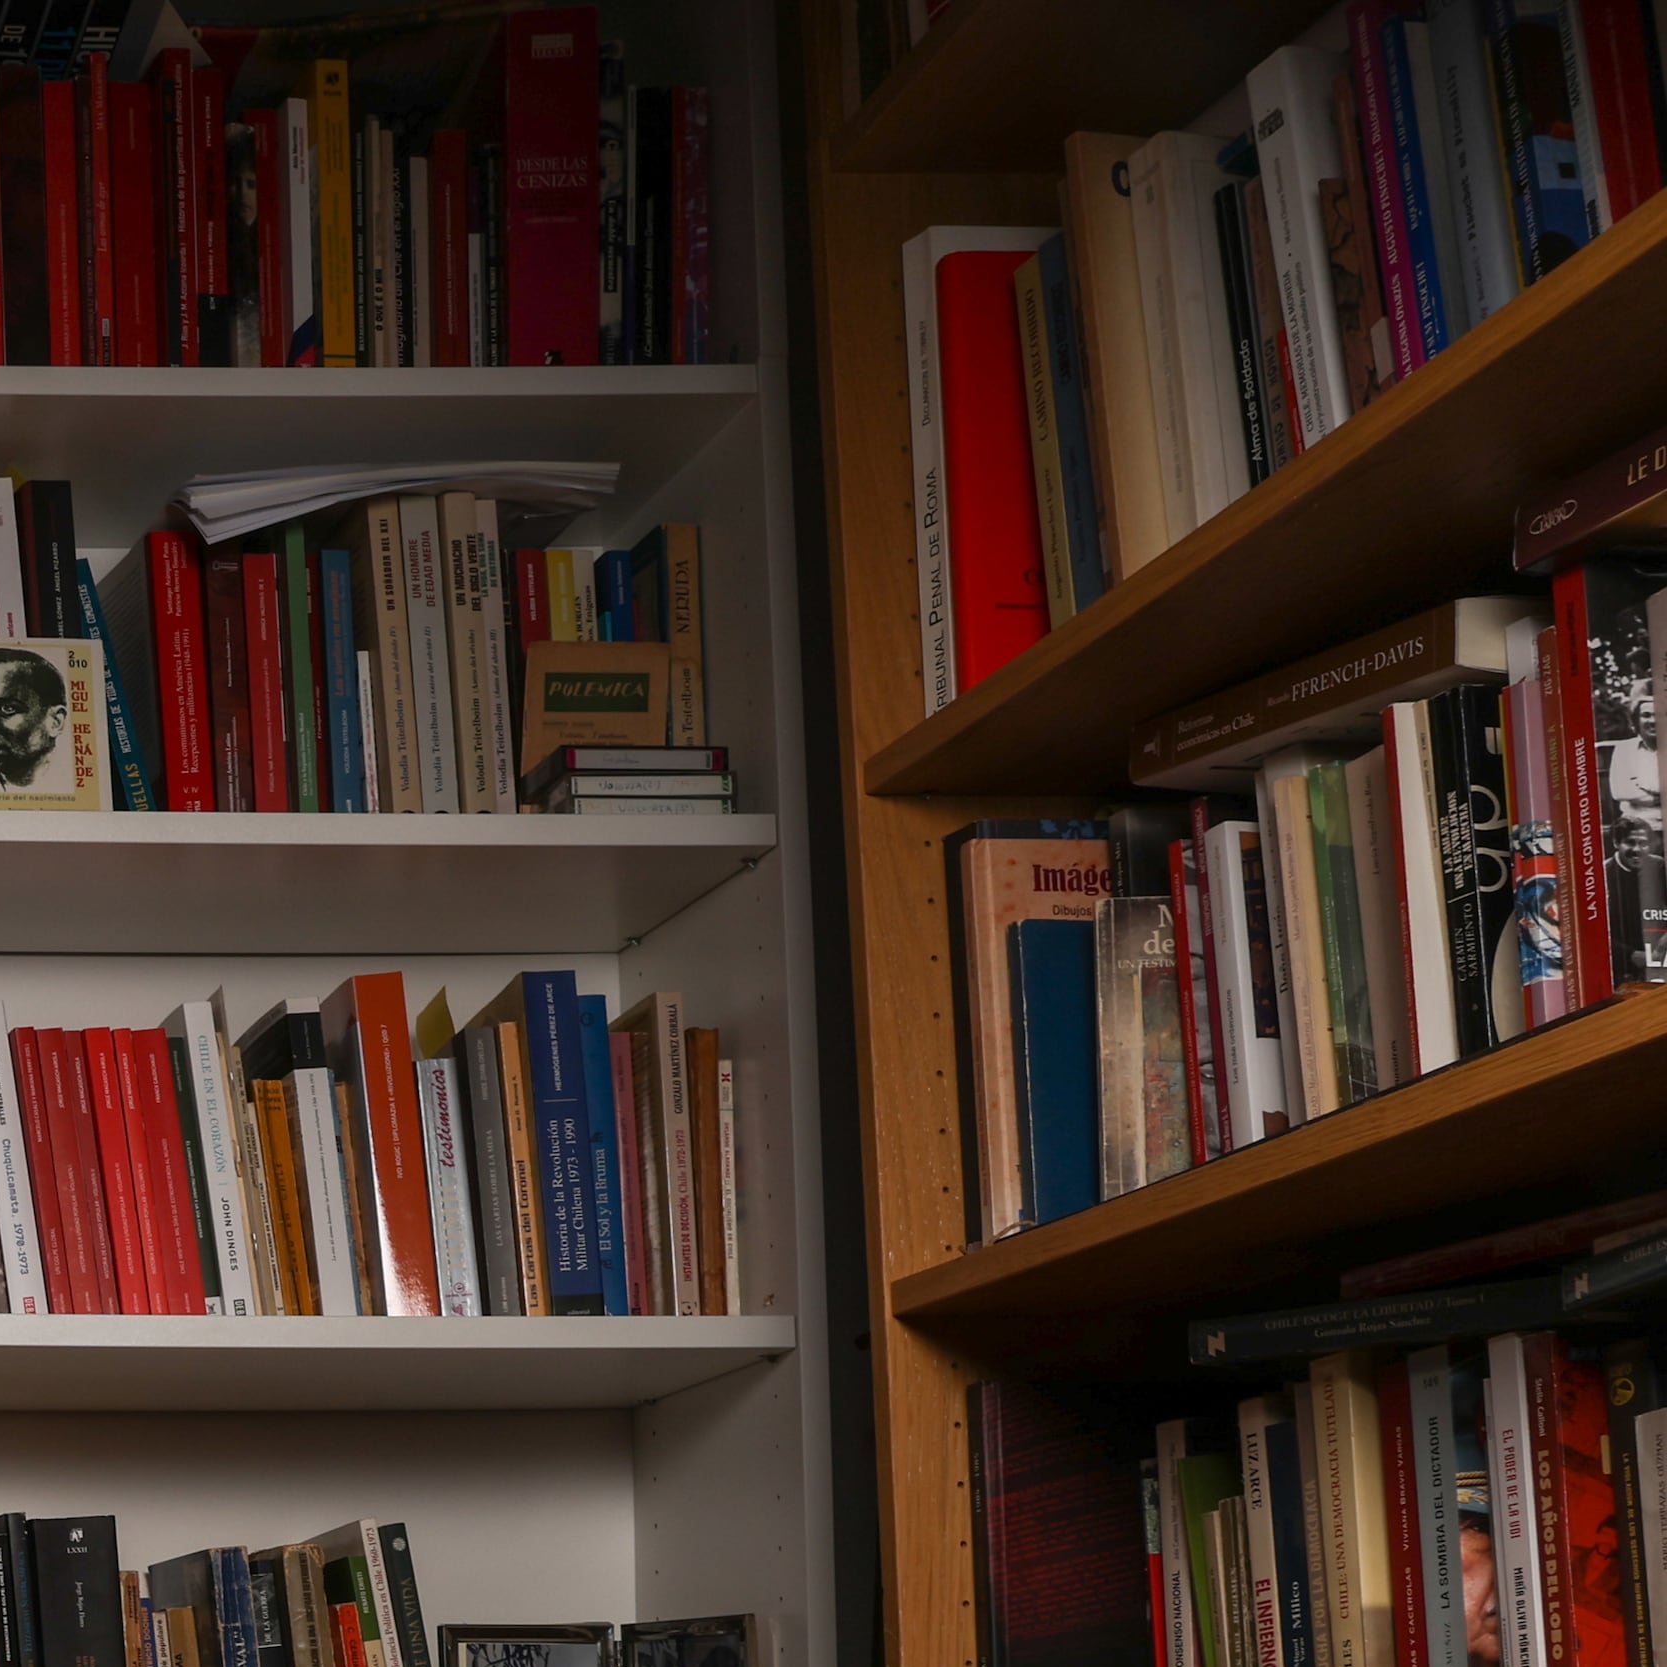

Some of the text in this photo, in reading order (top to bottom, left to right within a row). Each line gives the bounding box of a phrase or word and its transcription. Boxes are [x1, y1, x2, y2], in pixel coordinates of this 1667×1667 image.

[675, 560, 690, 633] NERUDA
[924, 467, 949, 712] RIBUNAL PENAL DE ROMA
[548, 681, 644, 697] POLEMICA
[1292, 636, 1424, 701] FFRENCH-DAVIS
[432, 1068, 455, 1167] testimonios
[563, 1118, 576, 1144] 1990
[546, 1119, 571, 1271] Historia de la Revolución
[566, 1156, 580, 1183] 1973
[594, 1148, 612, 1251] El Sol y la Bruma
[571, 1186, 584, 1230] Chilena
[574, 1231, 588, 1271] Militar
[1256, 1579, 1270, 1596] EL
[1537, 1450, 1563, 1660] LOS AÑOS DEL LOBO
